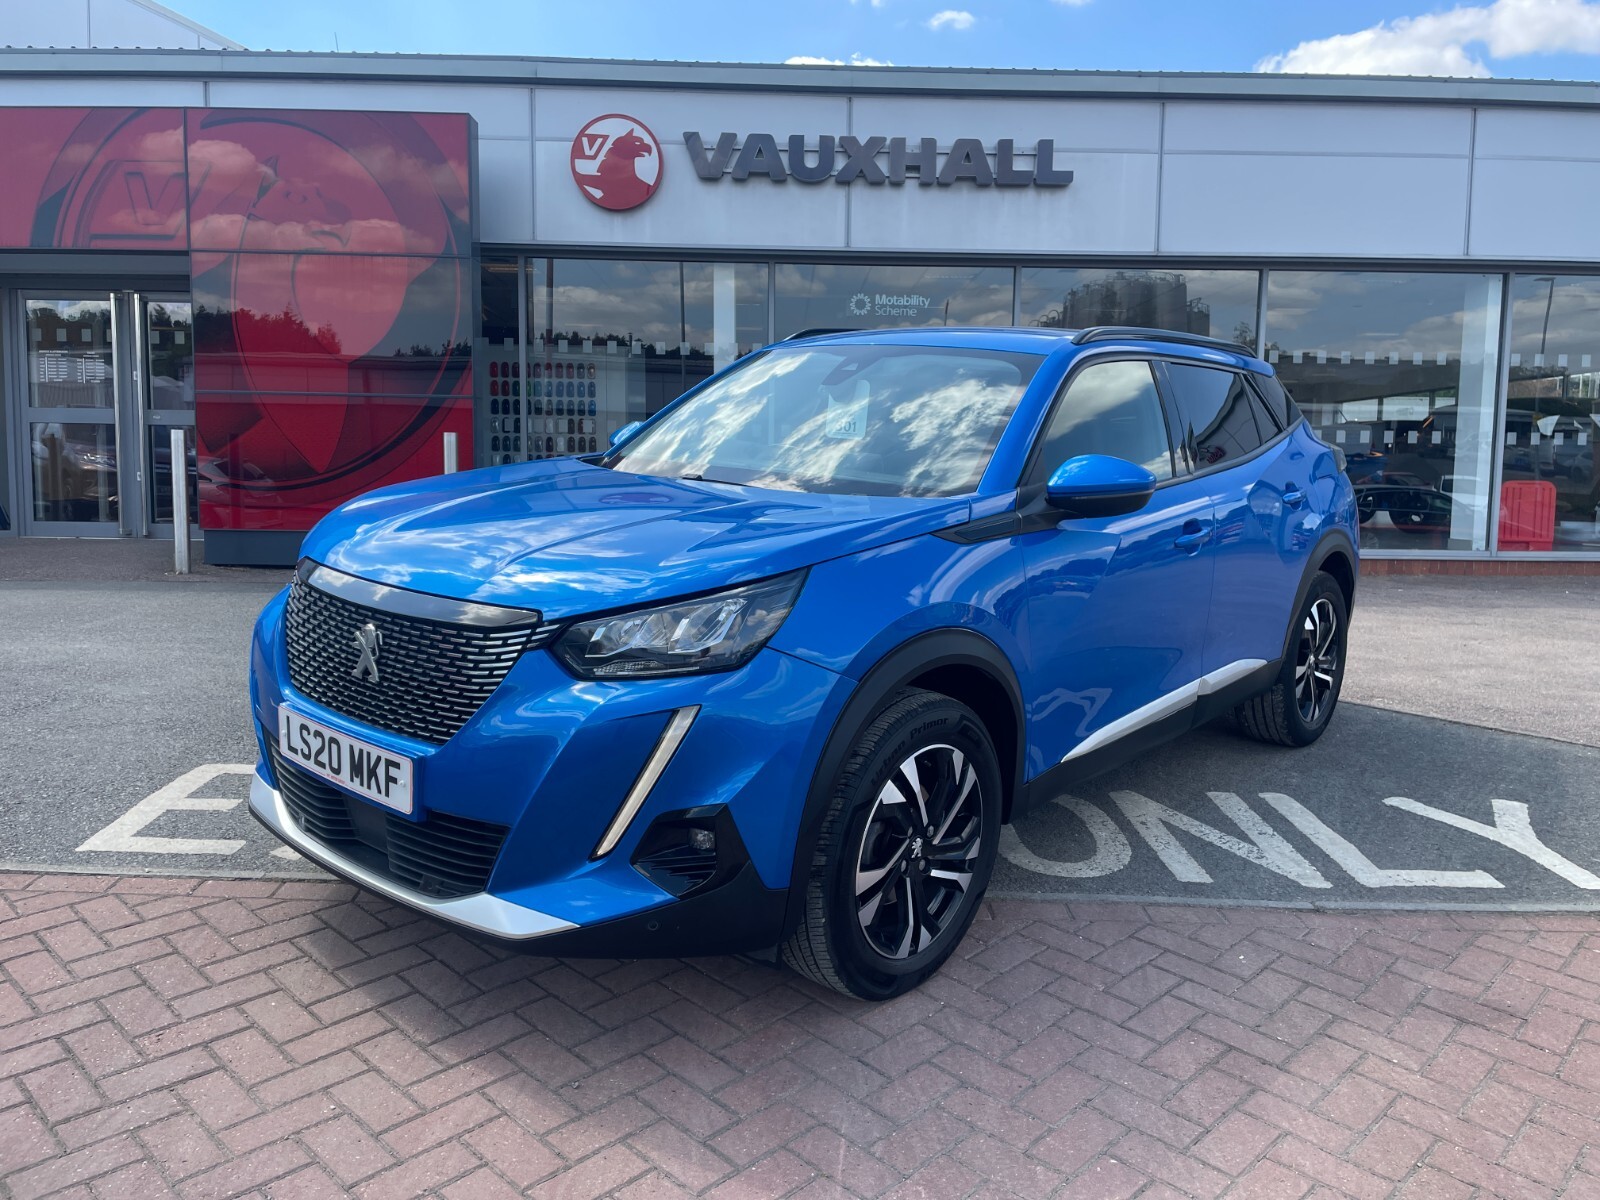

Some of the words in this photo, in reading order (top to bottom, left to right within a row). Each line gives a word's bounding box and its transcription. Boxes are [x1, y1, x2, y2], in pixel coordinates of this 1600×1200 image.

[682, 131, 1074, 187] VAUXHALL
[875, 293, 930, 308] Motability
[875, 305, 917, 316] Scheme
[286, 715, 342, 776] LS20
[349, 744, 401, 798] MKF
[998, 789, 1600, 890] ONLY
